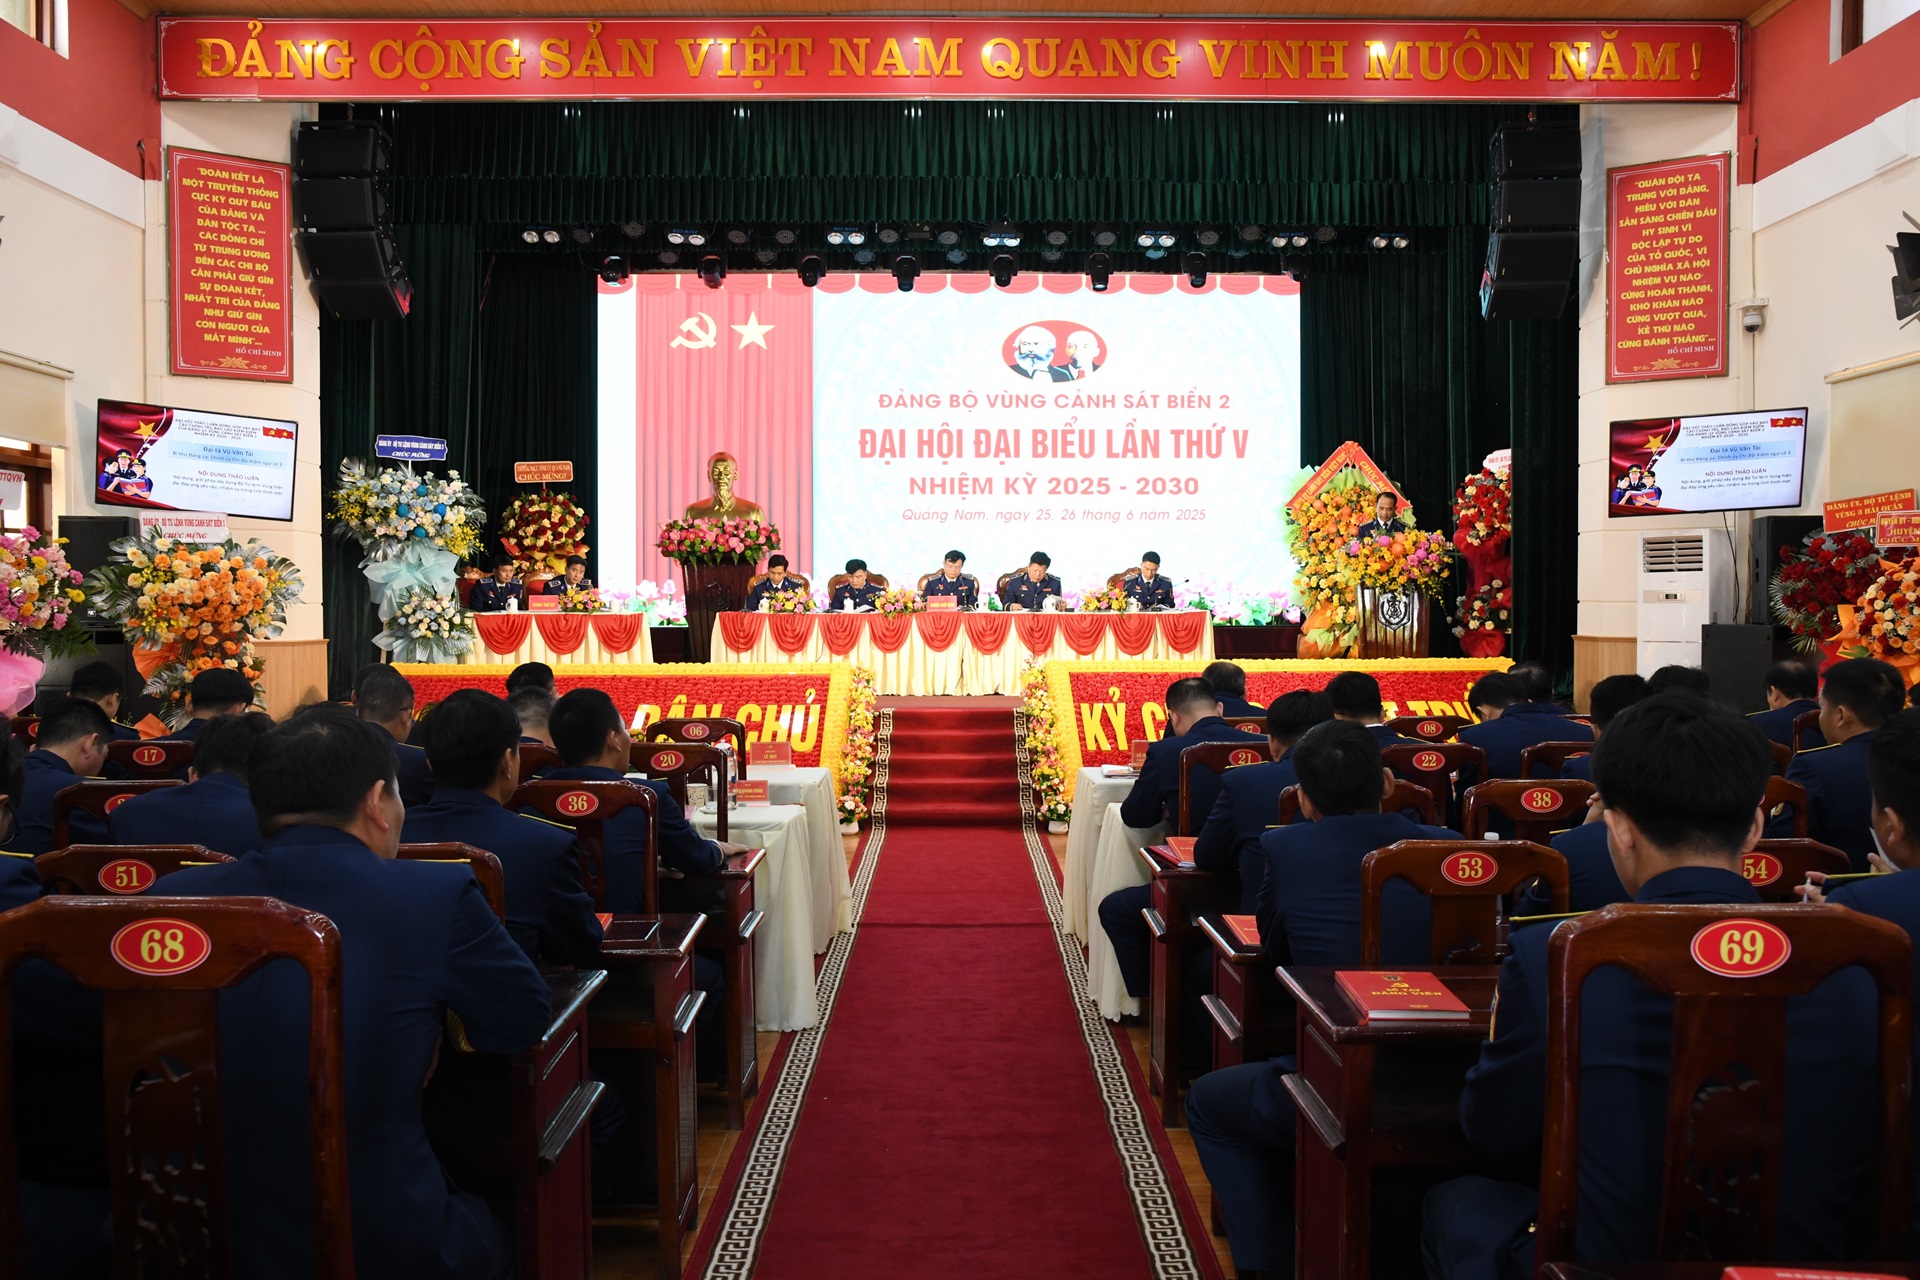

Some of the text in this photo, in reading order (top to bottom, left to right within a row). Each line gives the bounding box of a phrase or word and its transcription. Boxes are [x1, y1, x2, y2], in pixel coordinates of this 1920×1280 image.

[196, 20, 356, 80] ĐẢNG
[369, 25, 527, 91] CỘNG
[539, 20, 659, 78] SẢN
[674, 25, 813, 89] VIỆT
[828, 37, 964, 77] NAM
[980, 37, 1182, 81] QUANG
[1199, 39, 1350, 79] VINH
[1363, 28, 1534, 81] MUÔN
[231, 172, 250, 182] KẾT
[252, 176, 265, 184] LÀ
[1668, 175, 1684, 184] ĐỘI
[1687, 173, 1701, 181] TA
[182, 178, 279, 198] MỘT TRUYỀN THỐNG
[1626, 184, 1709, 202] TRUNG VỚI ĐẢNG,
[198, 205, 264, 221] CỦA ĐẢNG VÀ
[1635, 198, 1700, 213] HIẾU VỚI DÂN
[199, 232, 264, 246] CÁC ĐỒNG CHÍ
[1632, 235, 1703, 250] ĐỘC LẬP TỰ DO
[194, 243, 270, 259] TỪ TRUNG ƯƠNG
[195, 255, 269, 272] ĐẾN CÁC CHI BỘ
[1624, 265, 1642, 275] CHỦ
[1693, 259, 1710, 268] HỘI
[200, 282, 265, 297] SỰ ĐOÀN KẾT,
[1647, 288, 1675, 297] HOÀN
[1677, 284, 1713, 294] THÀNH,
[185, 293, 280, 310] NHẤT TRÍ CỦA ĐẢNG
[1630, 297, 1704, 311] KHÓ KHĂN NÀO
[1653, 312, 1680, 321] VƯỢT
[1683, 310, 1706, 318] QUA,
[236, 346, 246, 354] HỒ
[1668, 346, 1678, 354] HỒ
[878, 386, 1230, 412] ĐẢNG BỘ VÙNG CẢNH SÁT BIỂN 2
[859, 416, 1249, 465] ĐẠI HỘI ĐẠI BIỂU LẦN THỨ V
[519, 471, 567, 481] CHÚC MỪNG!
[909, 471, 993, 501] NHIỆM
[1004, 471, 1037, 495] KỲ
[1047, 477, 1111, 495] 2025
[1136, 477, 1199, 496] 2030
[1826, 502, 1849, 511] ĐẢNG
[1864, 497, 1876, 506] BỘ
[1877, 495, 1888, 503] TƯ
[1889, 491, 1912, 502] LỆNH
[902, 508, 949, 524] Quảng
[995, 510, 1031, 524] ngày
[1061, 510, 1077, 522] 26
[1082, 508, 1122, 524] tháng
[1126, 510, 1135, 522] 6
[1140, 509, 1170, 522] năm
[1175, 509, 1206, 522] 2025
[1835, 502, 1904, 519] VÙNG 3 HẢI QUÂN
[1846, 518, 1868, 528] CHÚC
[163, 530, 208, 539] CHÚC MỪNG
[732, 688, 821, 752] CHỦ
[1080, 686, 1129, 751] KỶ
[689, 725, 703, 737] 06
[1424, 724, 1436, 734] 08
[143, 750, 158, 763] 17
[660, 753, 676, 768] 20
[1238, 752, 1252, 766] 21
[1421, 754, 1437, 767] 22
[567, 795, 588, 812] 36
[1533, 791, 1552, 808] 38
[115, 866, 140, 887] 51
[1457, 858, 1483, 879] 53
[1742, 859, 1768, 879] 54
[140, 928, 185, 964] 68
[1719, 929, 1764, 965] 69
